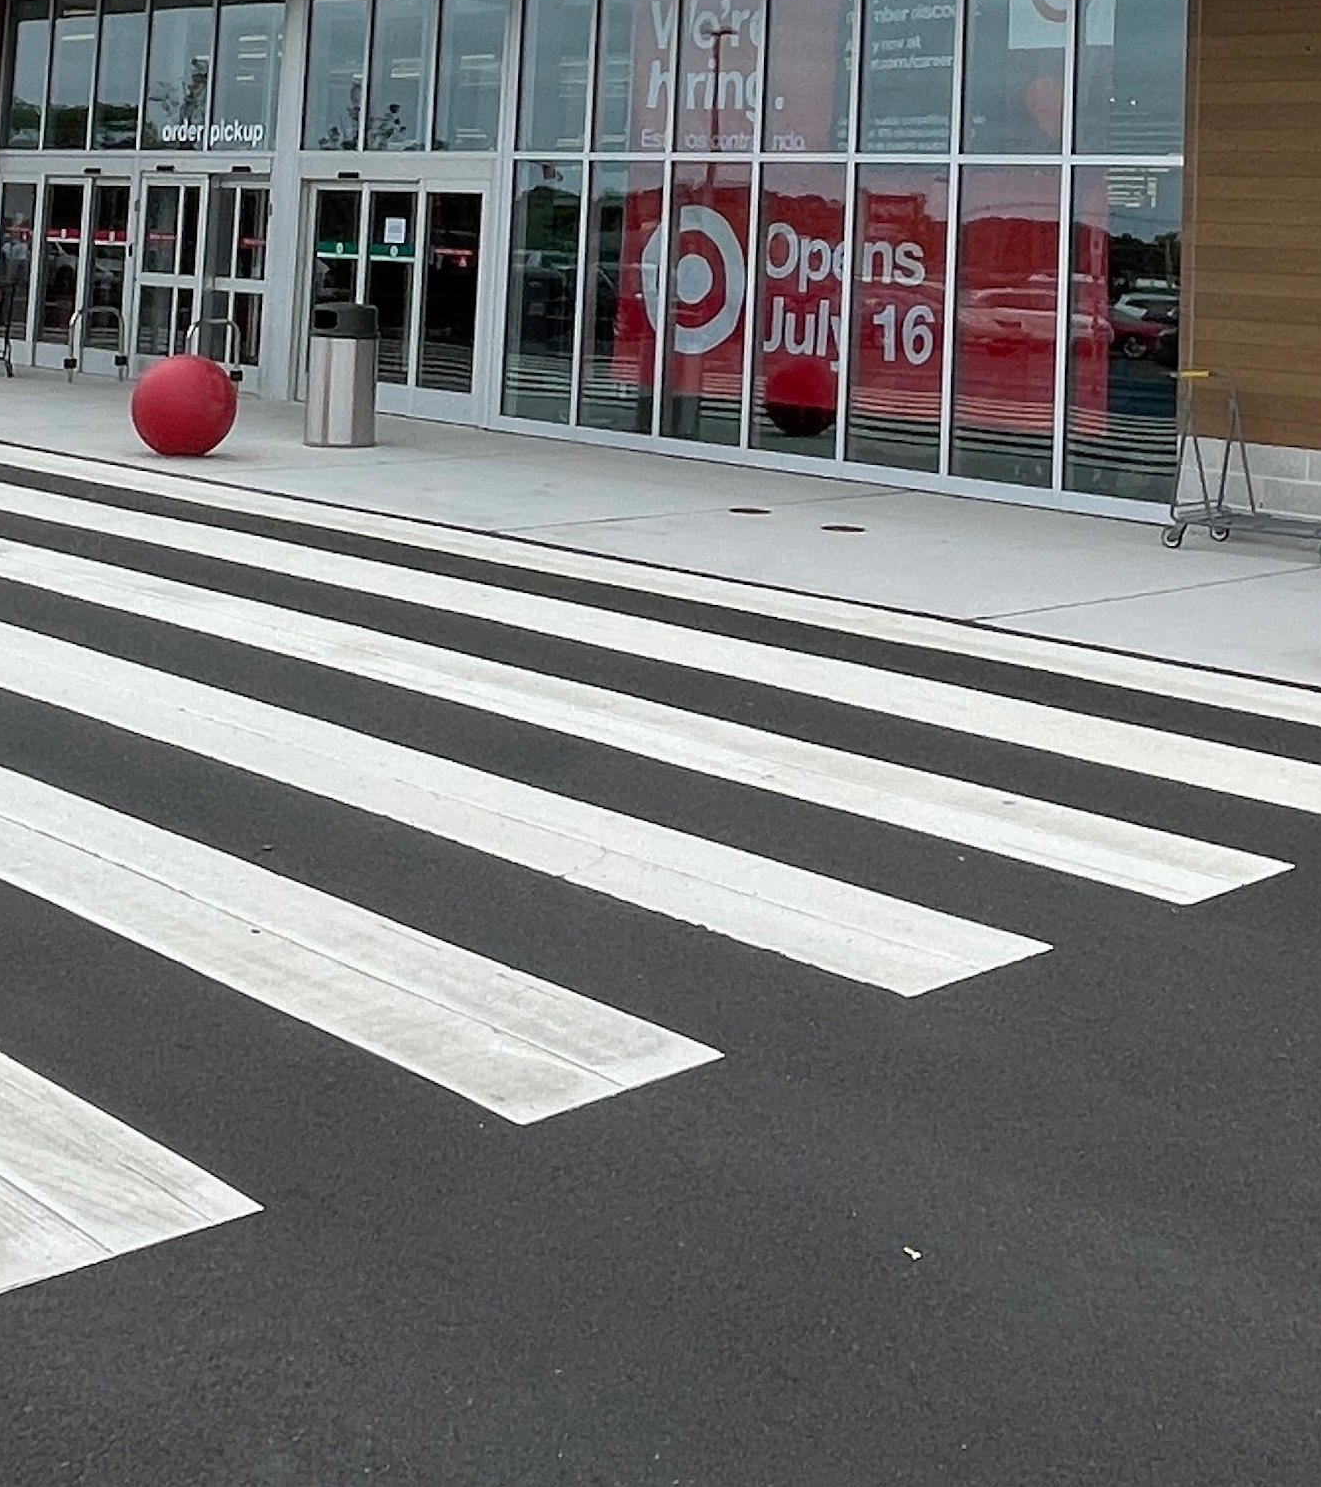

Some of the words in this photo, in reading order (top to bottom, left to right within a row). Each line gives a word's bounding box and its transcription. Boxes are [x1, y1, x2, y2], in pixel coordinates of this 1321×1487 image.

[645, 60, 785, 122] hring.
[162, 118, 205, 142] order
[210, 118, 264, 148] pickup
[873, 304, 936, 366] 16
